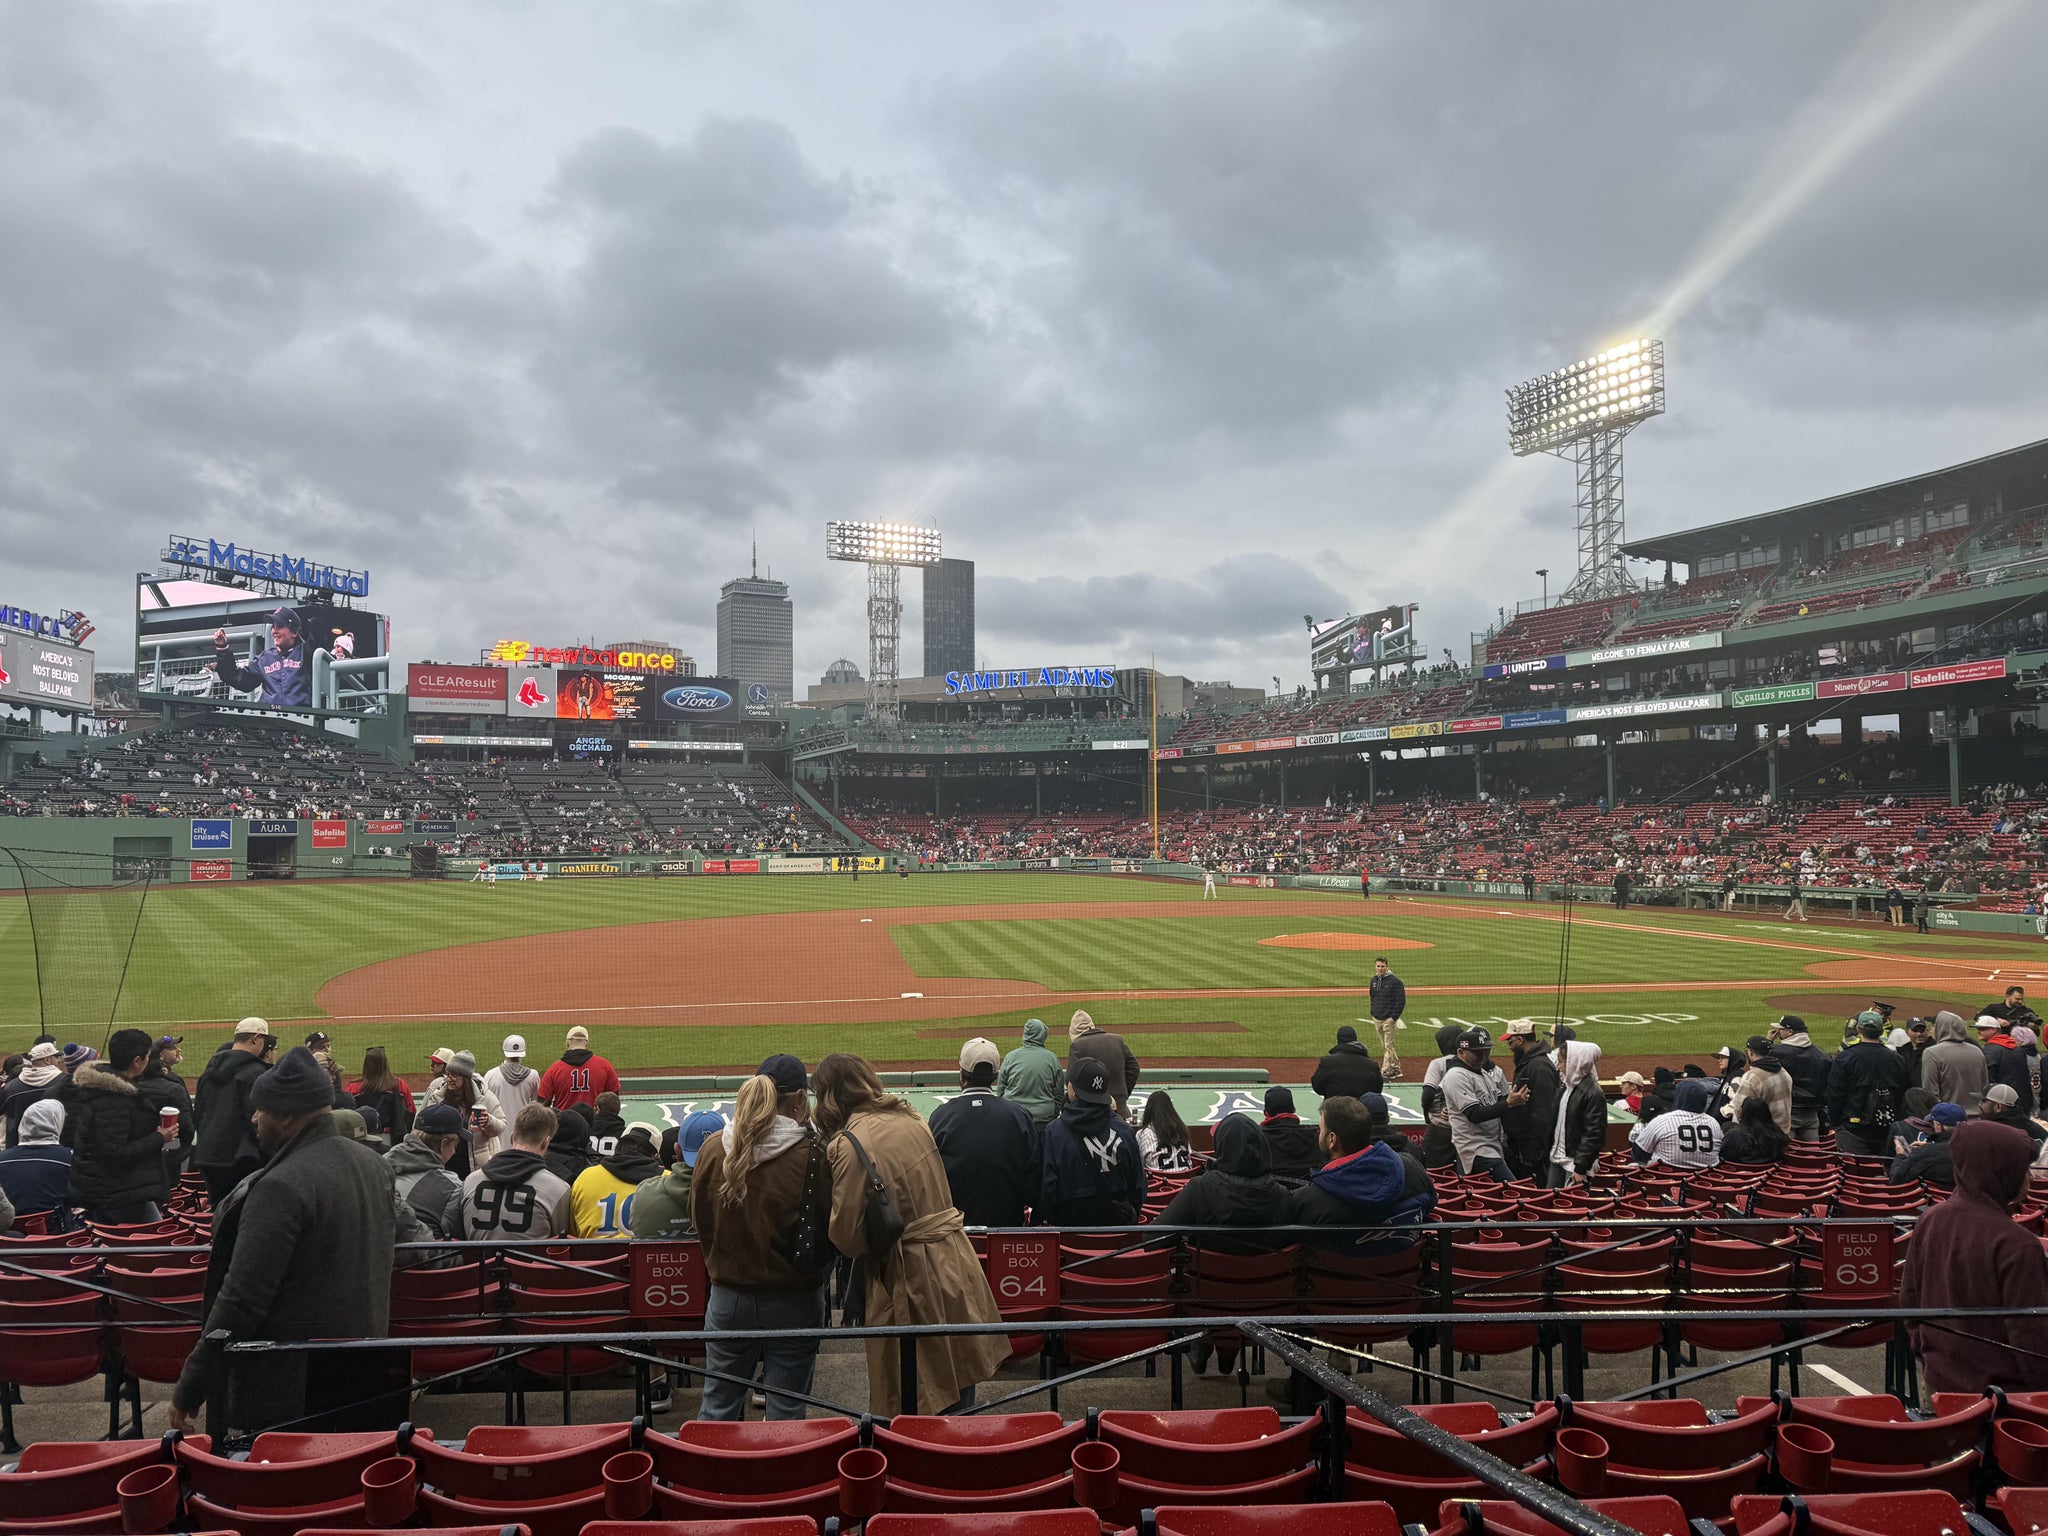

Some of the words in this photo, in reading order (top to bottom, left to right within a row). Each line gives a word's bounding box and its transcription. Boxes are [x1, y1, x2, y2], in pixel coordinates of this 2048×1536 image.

[209, 538, 369, 596] MassMutual
[534, 647, 579, 665] new
[583, 645, 675, 669] balance
[1592, 650, 1624, 661] WELCOME
[1626, 648, 1634, 656] TO
[1637, 643, 1667, 654] FENWAY
[1669, 640, 1690, 651] PARK
[40, 651, 73, 667] AMERICA'S
[1511, 660, 1547, 673] UNITED
[33, 664, 50, 677] MOST
[51, 668, 78, 683] BELOVED
[1913, 671, 1956, 684] Safelite
[419, 675, 497, 688] CLEAResult
[945, 670, 1034, 696] SAMUEL
[1037, 667, 1116, 689] ADAMS
[1835, 683, 1857, 692] Ninety
[40, 681, 72, 697] BALLPARK
[1744, 691, 1775, 702] GRILLO'S
[1778, 688, 1810, 698] PICKLES
[677, 690, 718, 708] Ford
[1576, 708, 1612, 719] AMERICA'S
[1613, 706, 1631, 715] MOST
[1634, 702, 1667, 712] BELOVED
[1669, 698, 1710, 710] BALLPARK
[576, 737, 607, 745] ANGRY
[1113, 741, 1127, 749] 6:21
[569, 744, 613, 752] ORCHARD
[194, 827, 207, 835] city
[381, 823, 402, 831] TICKET
[332, 857, 343, 865] 420
[561, 864, 599, 873] GRANITE
[1320, 877, 1350, 887] L.L.Bean
[1475, 884, 1485, 892] JIM
[570, 1068, 591, 1092] 11
[1677, 1125, 1714, 1153] 99
[471, 1180, 537, 1233] 99
[1838, 1233, 1878, 1243] FIELD
[1002, 1243, 1044, 1254] FIELD
[1844, 1247, 1872, 1256] BOX
[646, 1253, 689, 1263] FIELD
[1009, 1257, 1038, 1268] BOX
[652, 1267, 683, 1277] BOX
[1836, 1263, 1879, 1285] 63
[1000, 1275, 1047, 1297] 64
[645, 1285, 690, 1307] 65
